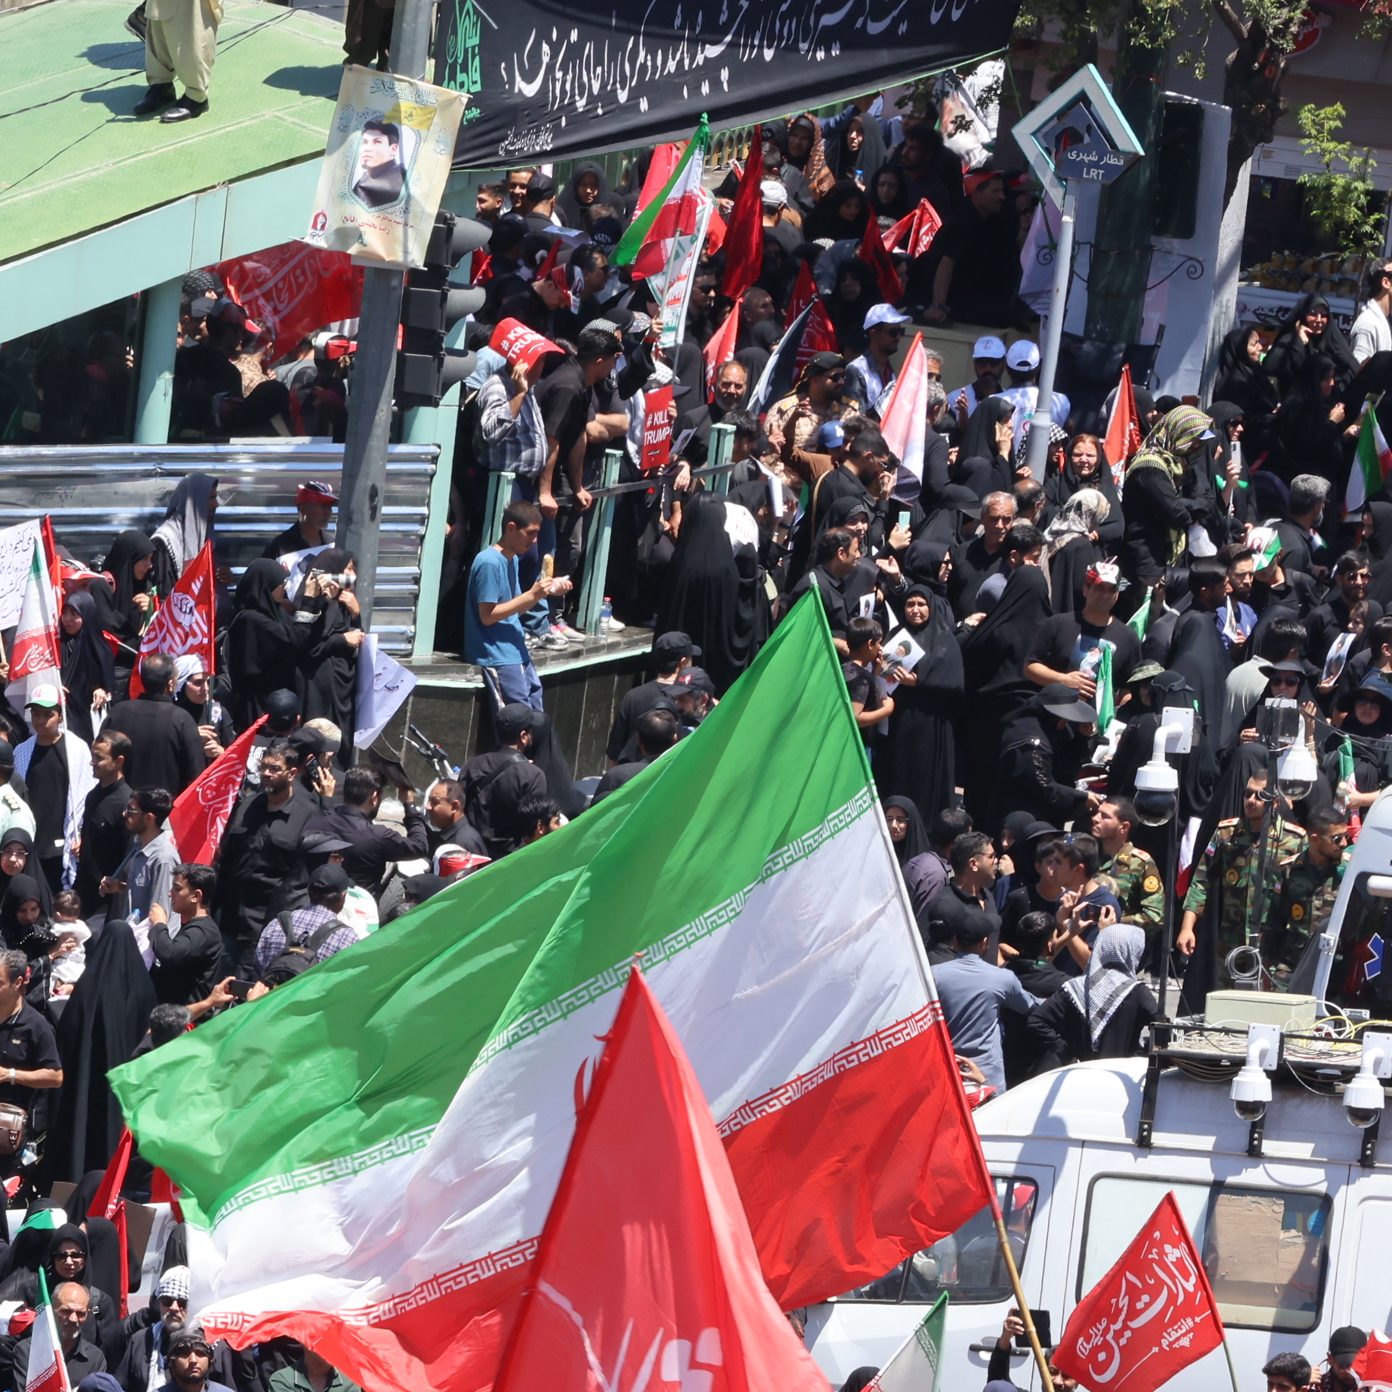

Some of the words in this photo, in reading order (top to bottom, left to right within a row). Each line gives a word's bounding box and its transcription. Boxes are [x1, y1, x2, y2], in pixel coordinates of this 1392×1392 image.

[1068, 150, 1098, 163] شهری
[1100, 154, 1124, 165] قطار
[1083, 167, 1105, 180] LRT
[654, 409, 669, 426] KILL
